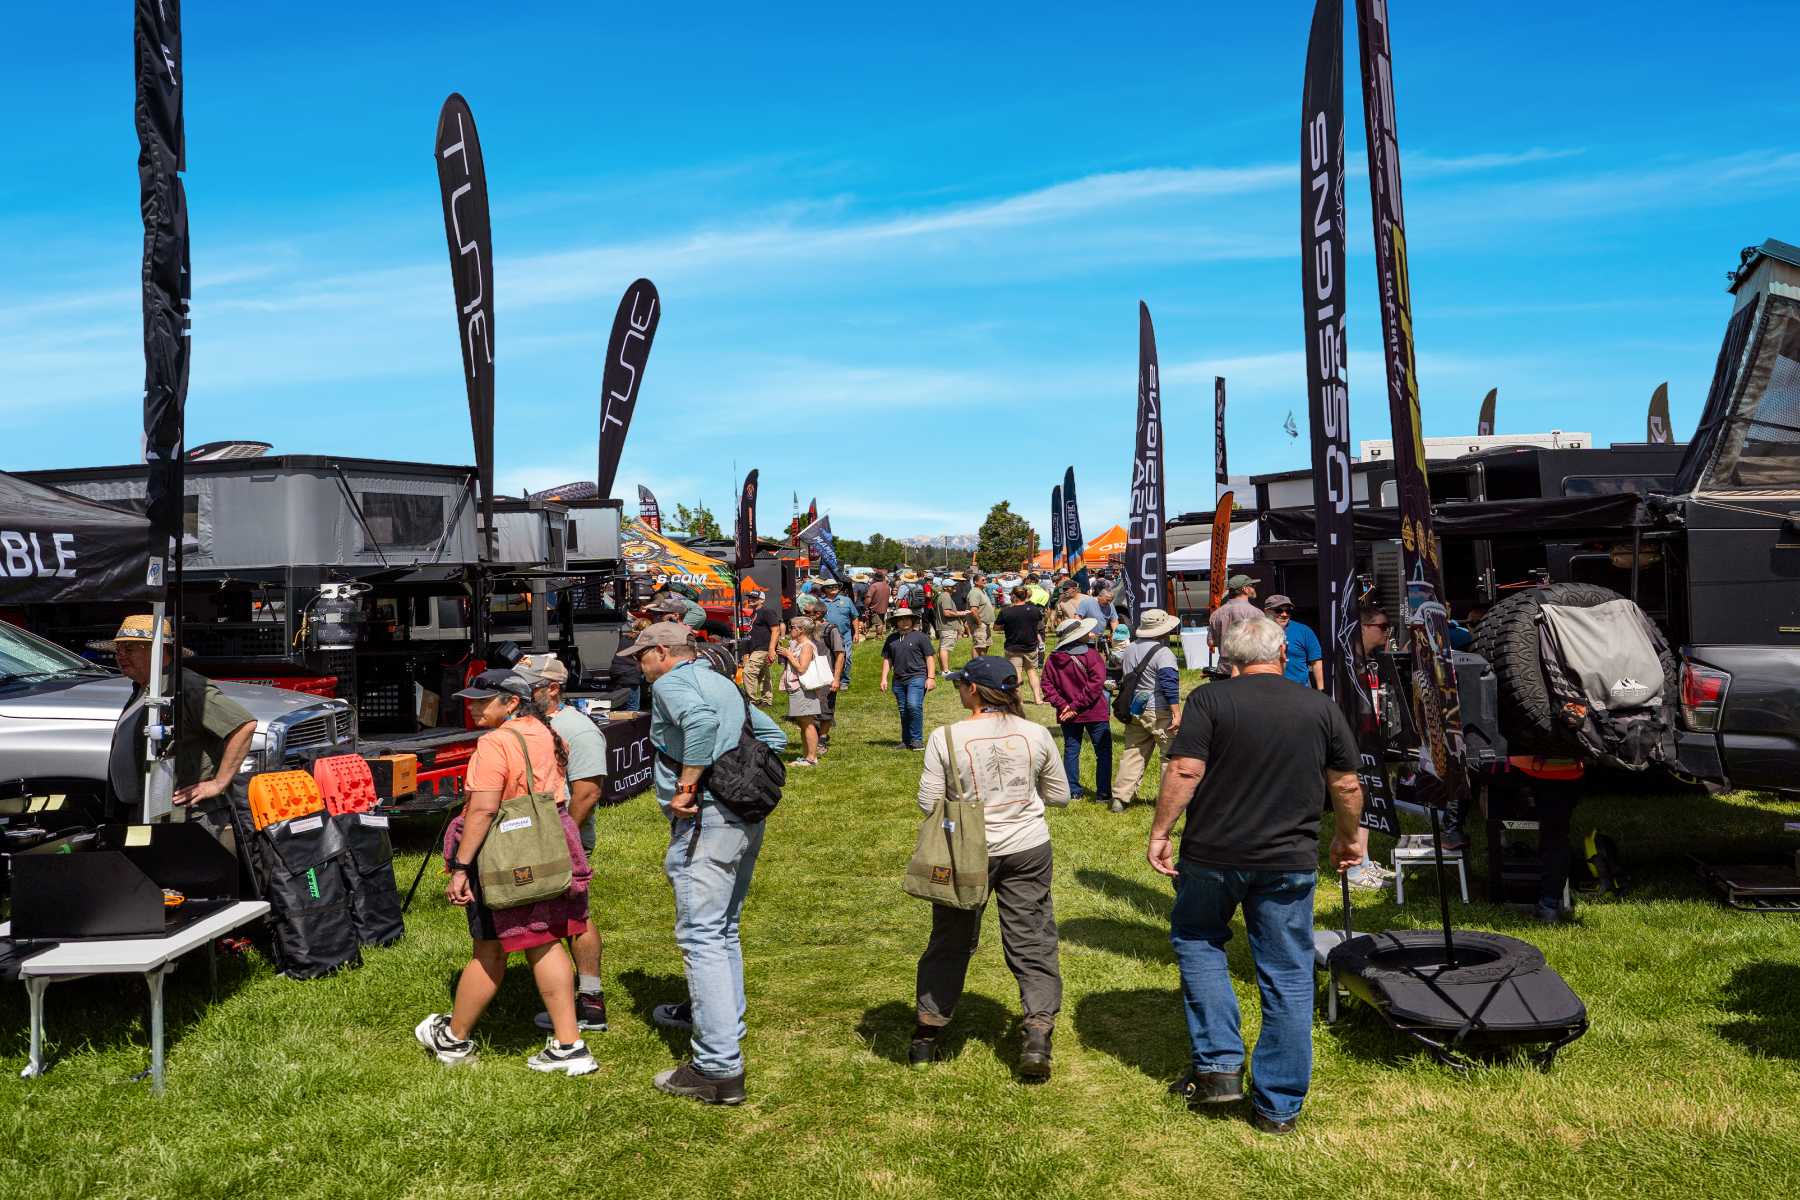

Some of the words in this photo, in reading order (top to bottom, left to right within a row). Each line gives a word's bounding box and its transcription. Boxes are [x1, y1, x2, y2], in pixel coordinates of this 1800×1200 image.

[443, 112, 492, 378] TUNE
[602, 291, 656, 433] TUNE
[612, 737, 651, 773] TUNE
[1369, 791, 1387, 809] in
